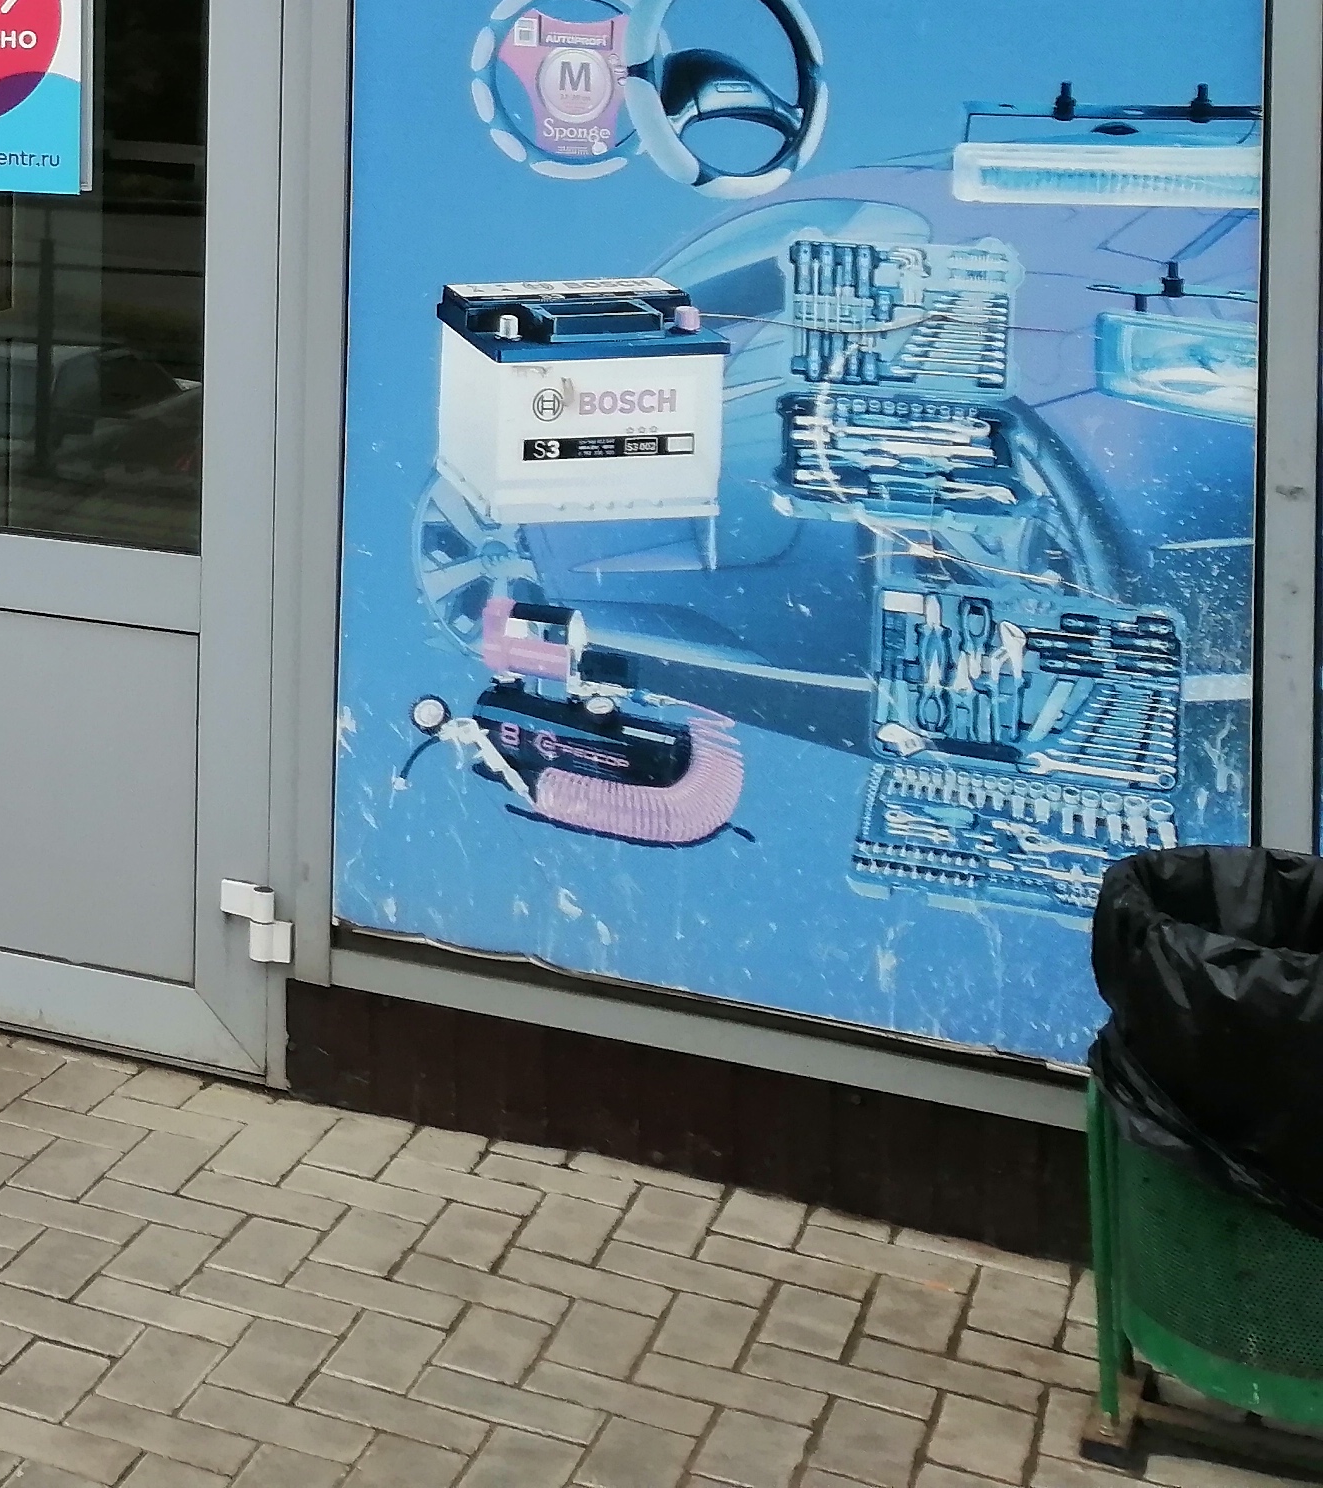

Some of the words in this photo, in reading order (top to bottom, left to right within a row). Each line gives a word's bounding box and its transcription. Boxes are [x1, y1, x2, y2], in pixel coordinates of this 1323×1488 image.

[559, 61, 592, 93] M
[543, 119, 611, 142] Sponge
[579, 388, 677, 415] BOSCH
[533, 440, 560, 459] S3
